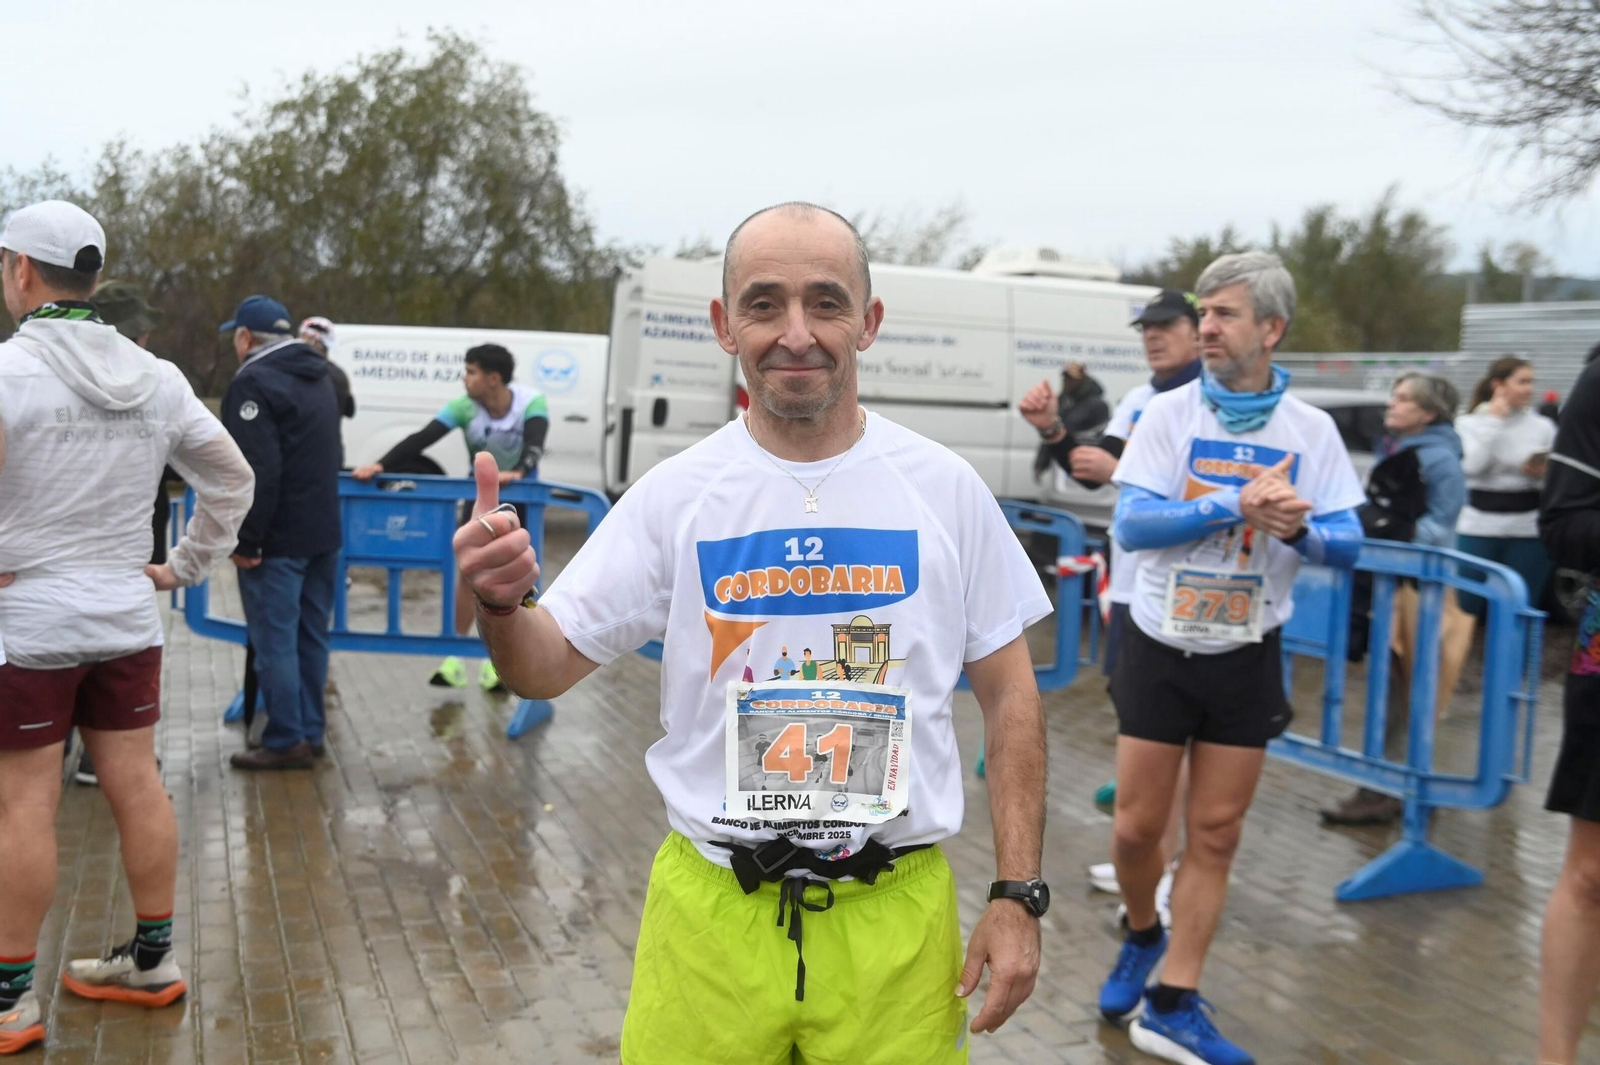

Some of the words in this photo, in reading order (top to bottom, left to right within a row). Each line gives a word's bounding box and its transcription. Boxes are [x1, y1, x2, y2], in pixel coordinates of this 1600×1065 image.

[353, 348, 407, 361] BANCO
[411, 349, 429, 362] DE
[433, 367, 464, 382] AZA
[1233, 446, 1255, 462] 12
[785, 536, 824, 562] 12
[714, 564, 906, 604] CORDOBARIA
[1173, 586, 1251, 624] 279
[811, 690, 841, 700] 12
[749, 698, 898, 716] CORDOBARIA
[762, 722, 853, 785] 41
[889, 743, 900, 779] NAVIDAD
[887, 779, 896, 791] EN
[711, 816, 749, 830] BANCO
[762, 820, 820, 831] ALIMENTOS
[776, 829, 825, 841] DICIMBRE
[827, 830, 852, 840] 2025
